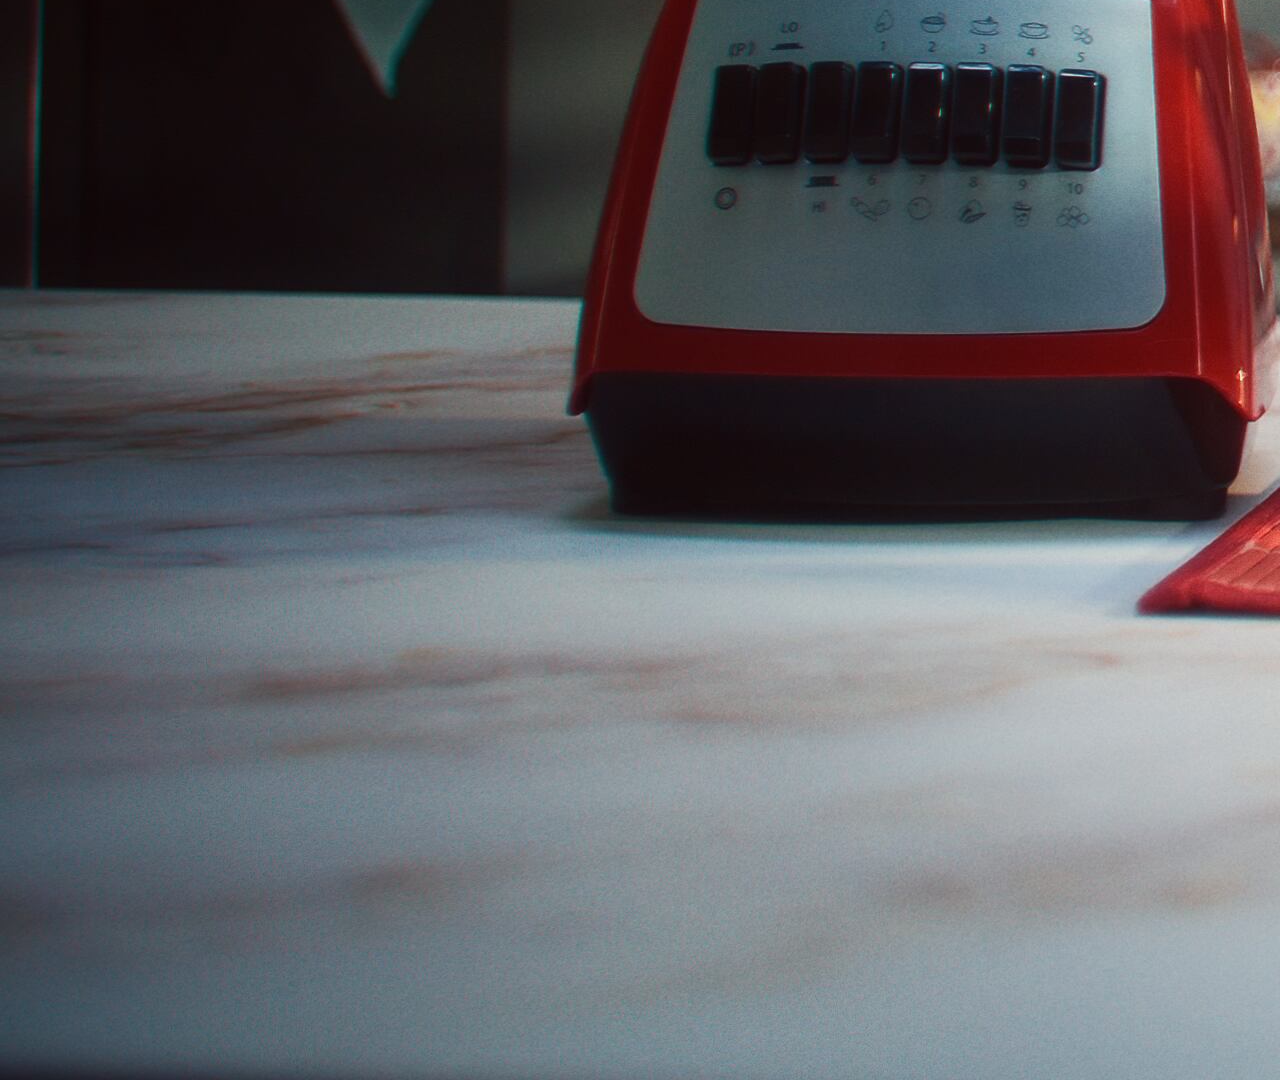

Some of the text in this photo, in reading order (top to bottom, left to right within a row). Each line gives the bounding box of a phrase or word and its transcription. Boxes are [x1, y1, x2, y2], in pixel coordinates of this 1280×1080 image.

[881, 41, 1085, 63] 1 2 3 4 5
[919, 174, 927, 185] 7
[1018, 179, 1027, 190] 9
[1068, 183, 1084, 195] 10
